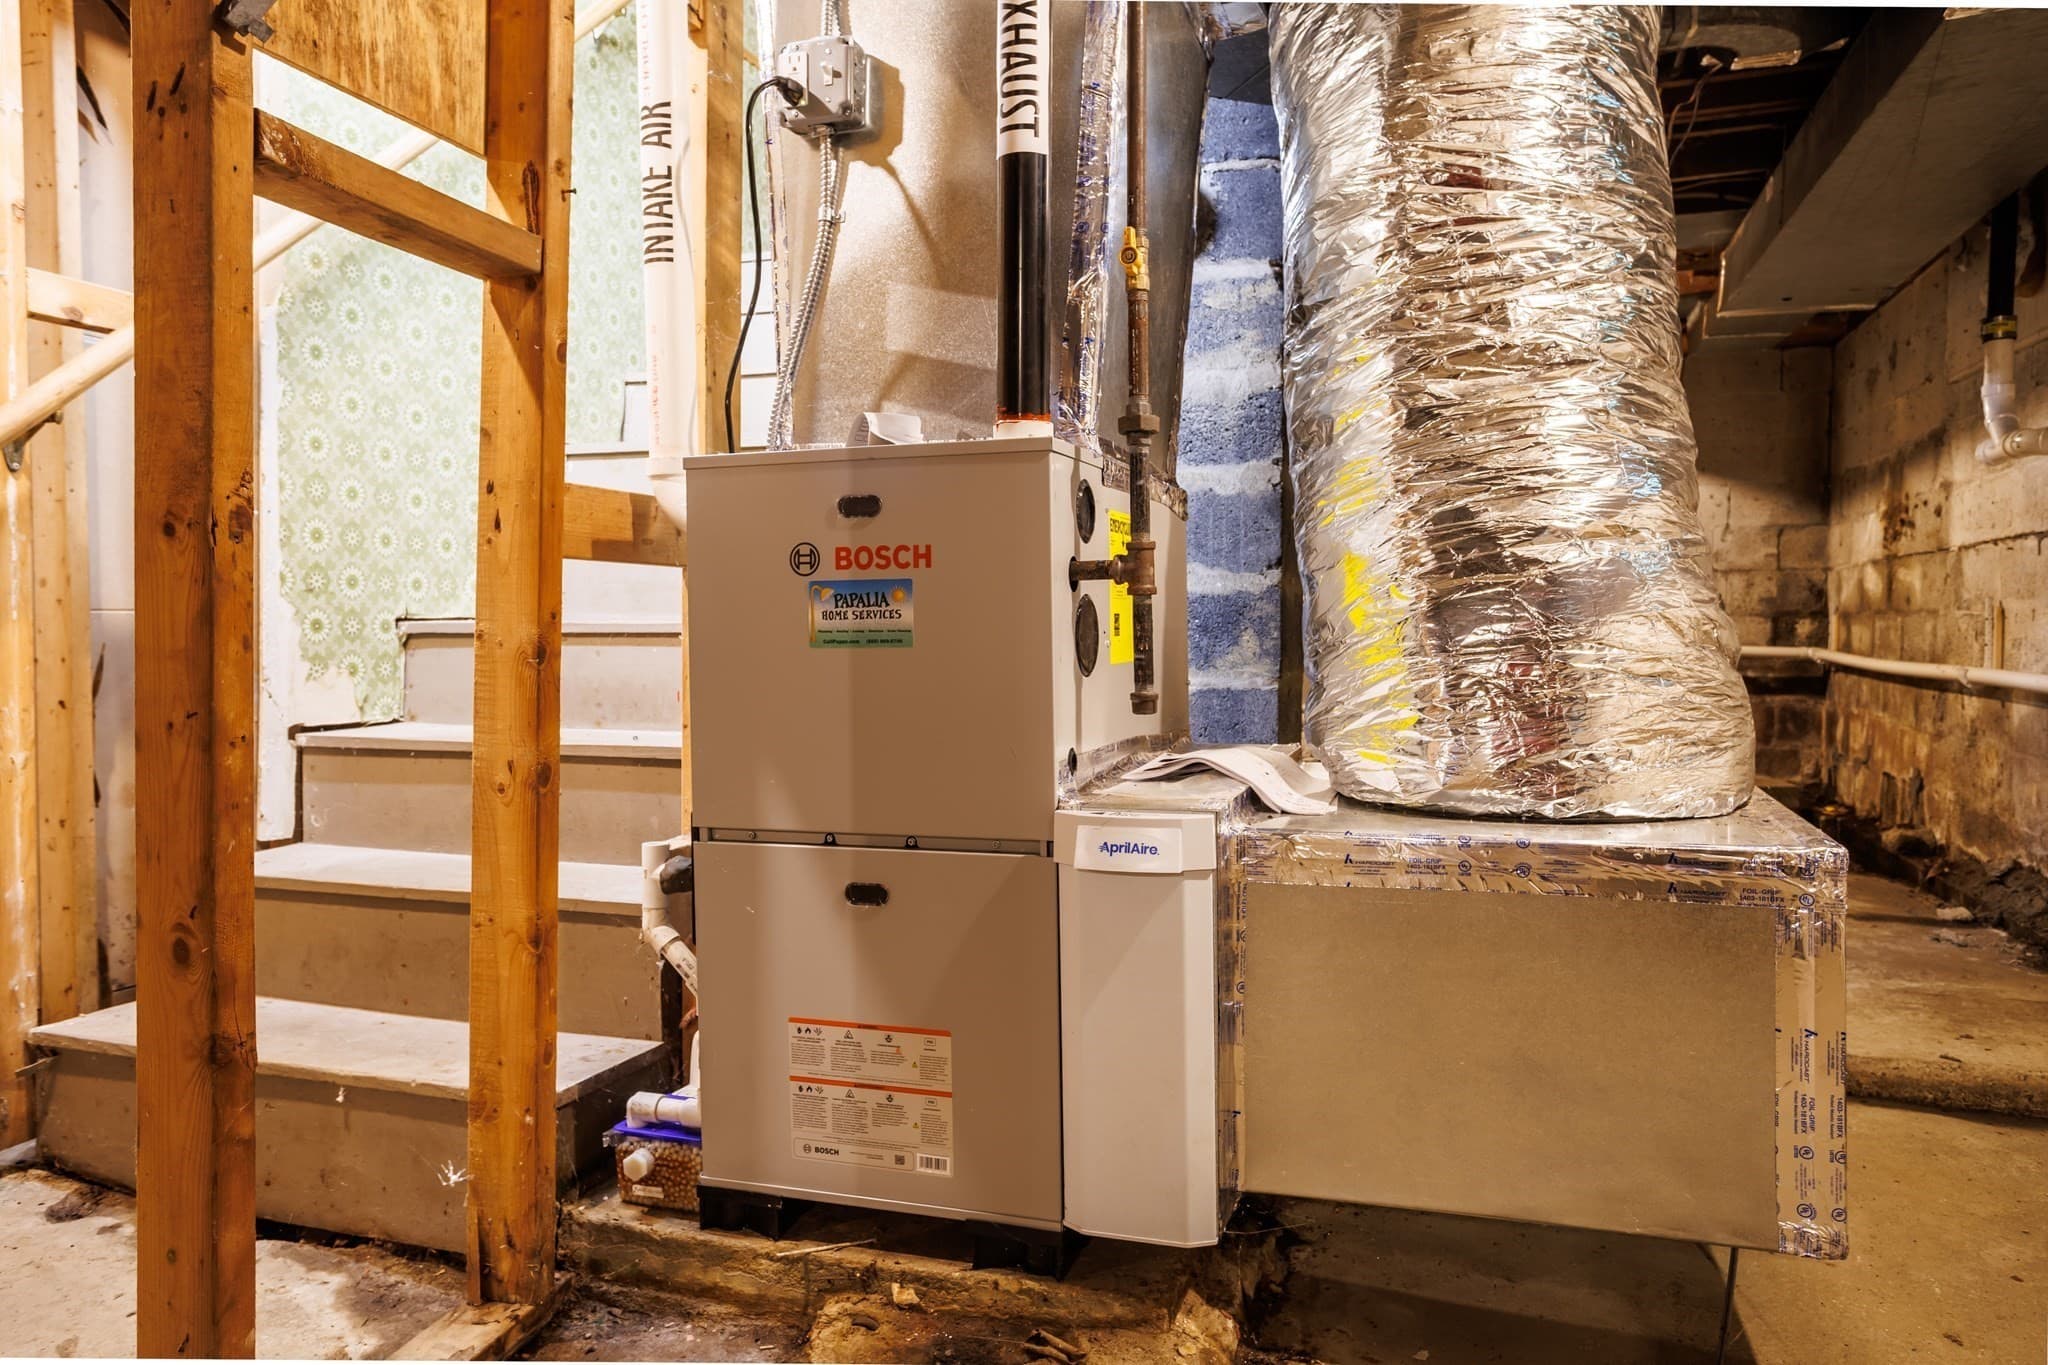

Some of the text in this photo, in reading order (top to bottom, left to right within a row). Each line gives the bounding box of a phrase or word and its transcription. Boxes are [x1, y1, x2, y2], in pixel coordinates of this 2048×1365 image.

[641, 101, 672, 150] AIR
[834, 544, 932, 570] BOSCH
[833, 591, 890, 609] PAPALIA
[822, 609, 902, 621] HOME SERVICES
[1099, 841, 1158, 856] AprilAire
[814, 1146, 840, 1156] BOSCH
